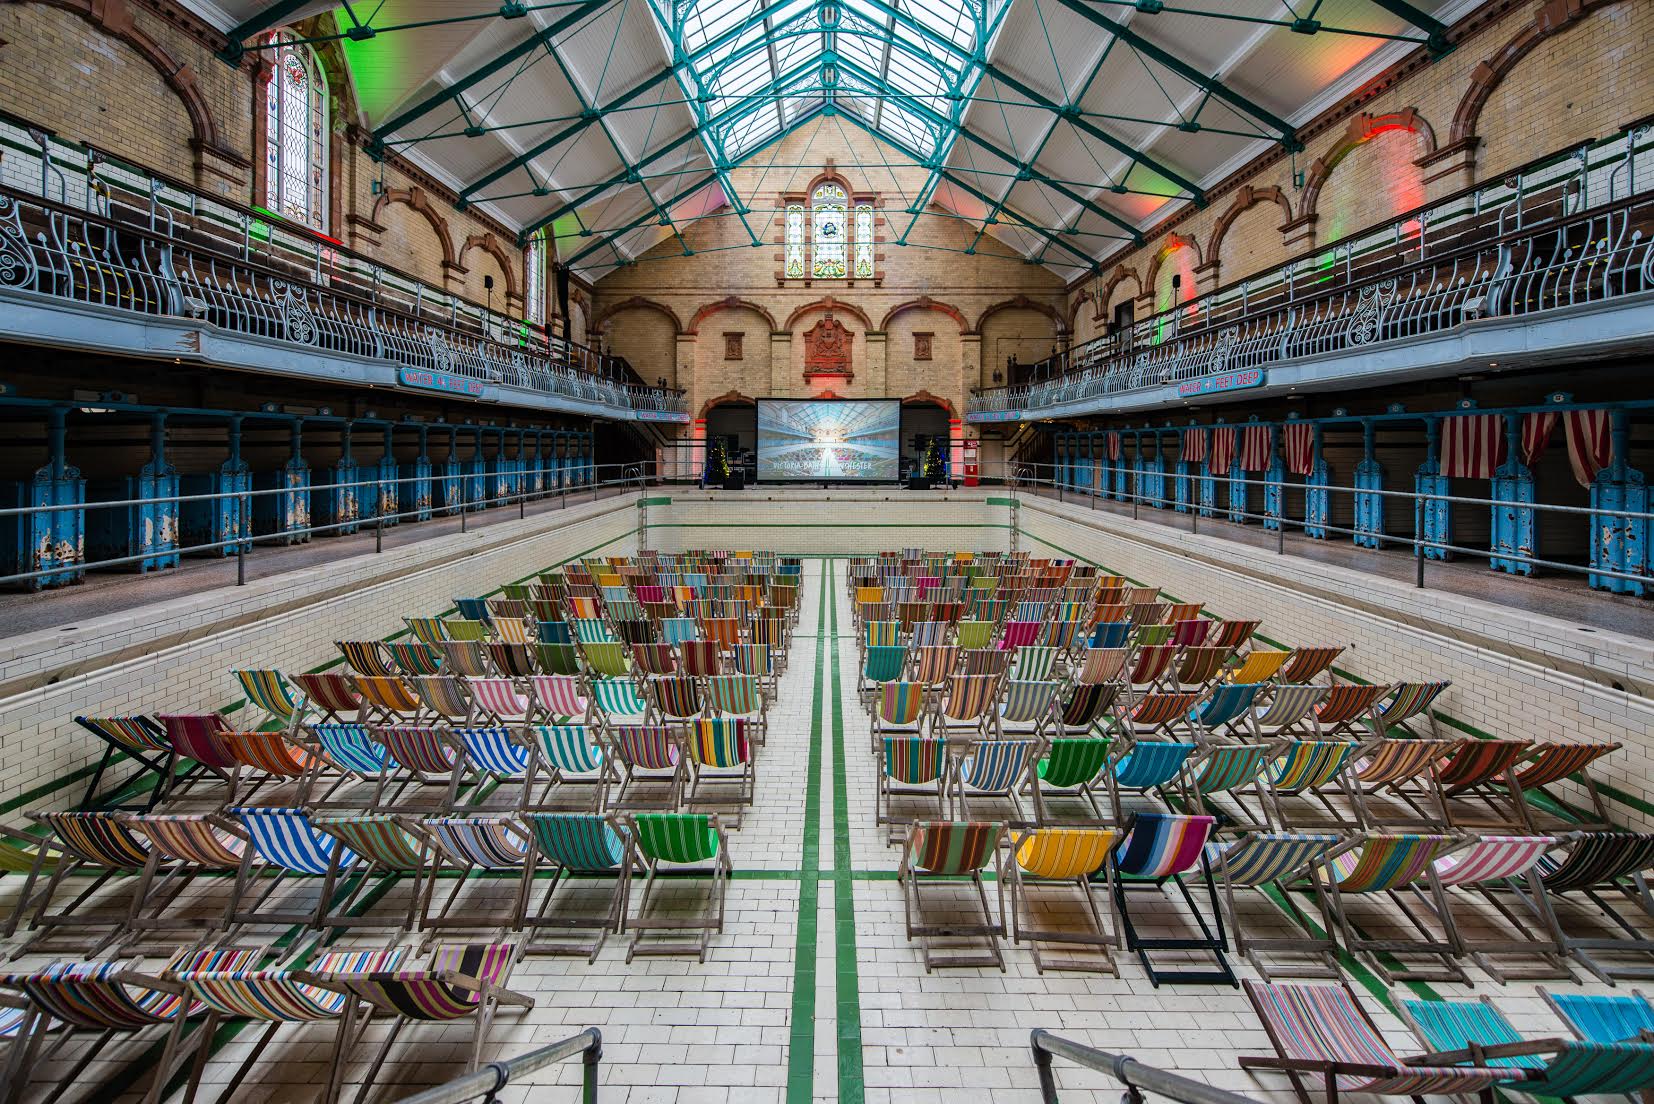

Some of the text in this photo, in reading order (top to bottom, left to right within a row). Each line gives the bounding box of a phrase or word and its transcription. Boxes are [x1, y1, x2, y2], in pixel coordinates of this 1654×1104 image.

[1504, 176, 1518, 184] ROW
[404, 371, 433, 385] WATER
[449, 378, 465, 391] FEET
[1179, 381, 1202, 394] WATER
[1215, 375, 1234, 389] FEET
[1236, 371, 1259, 386] DEEP
[773, 461, 801, 470] VICTORIA
